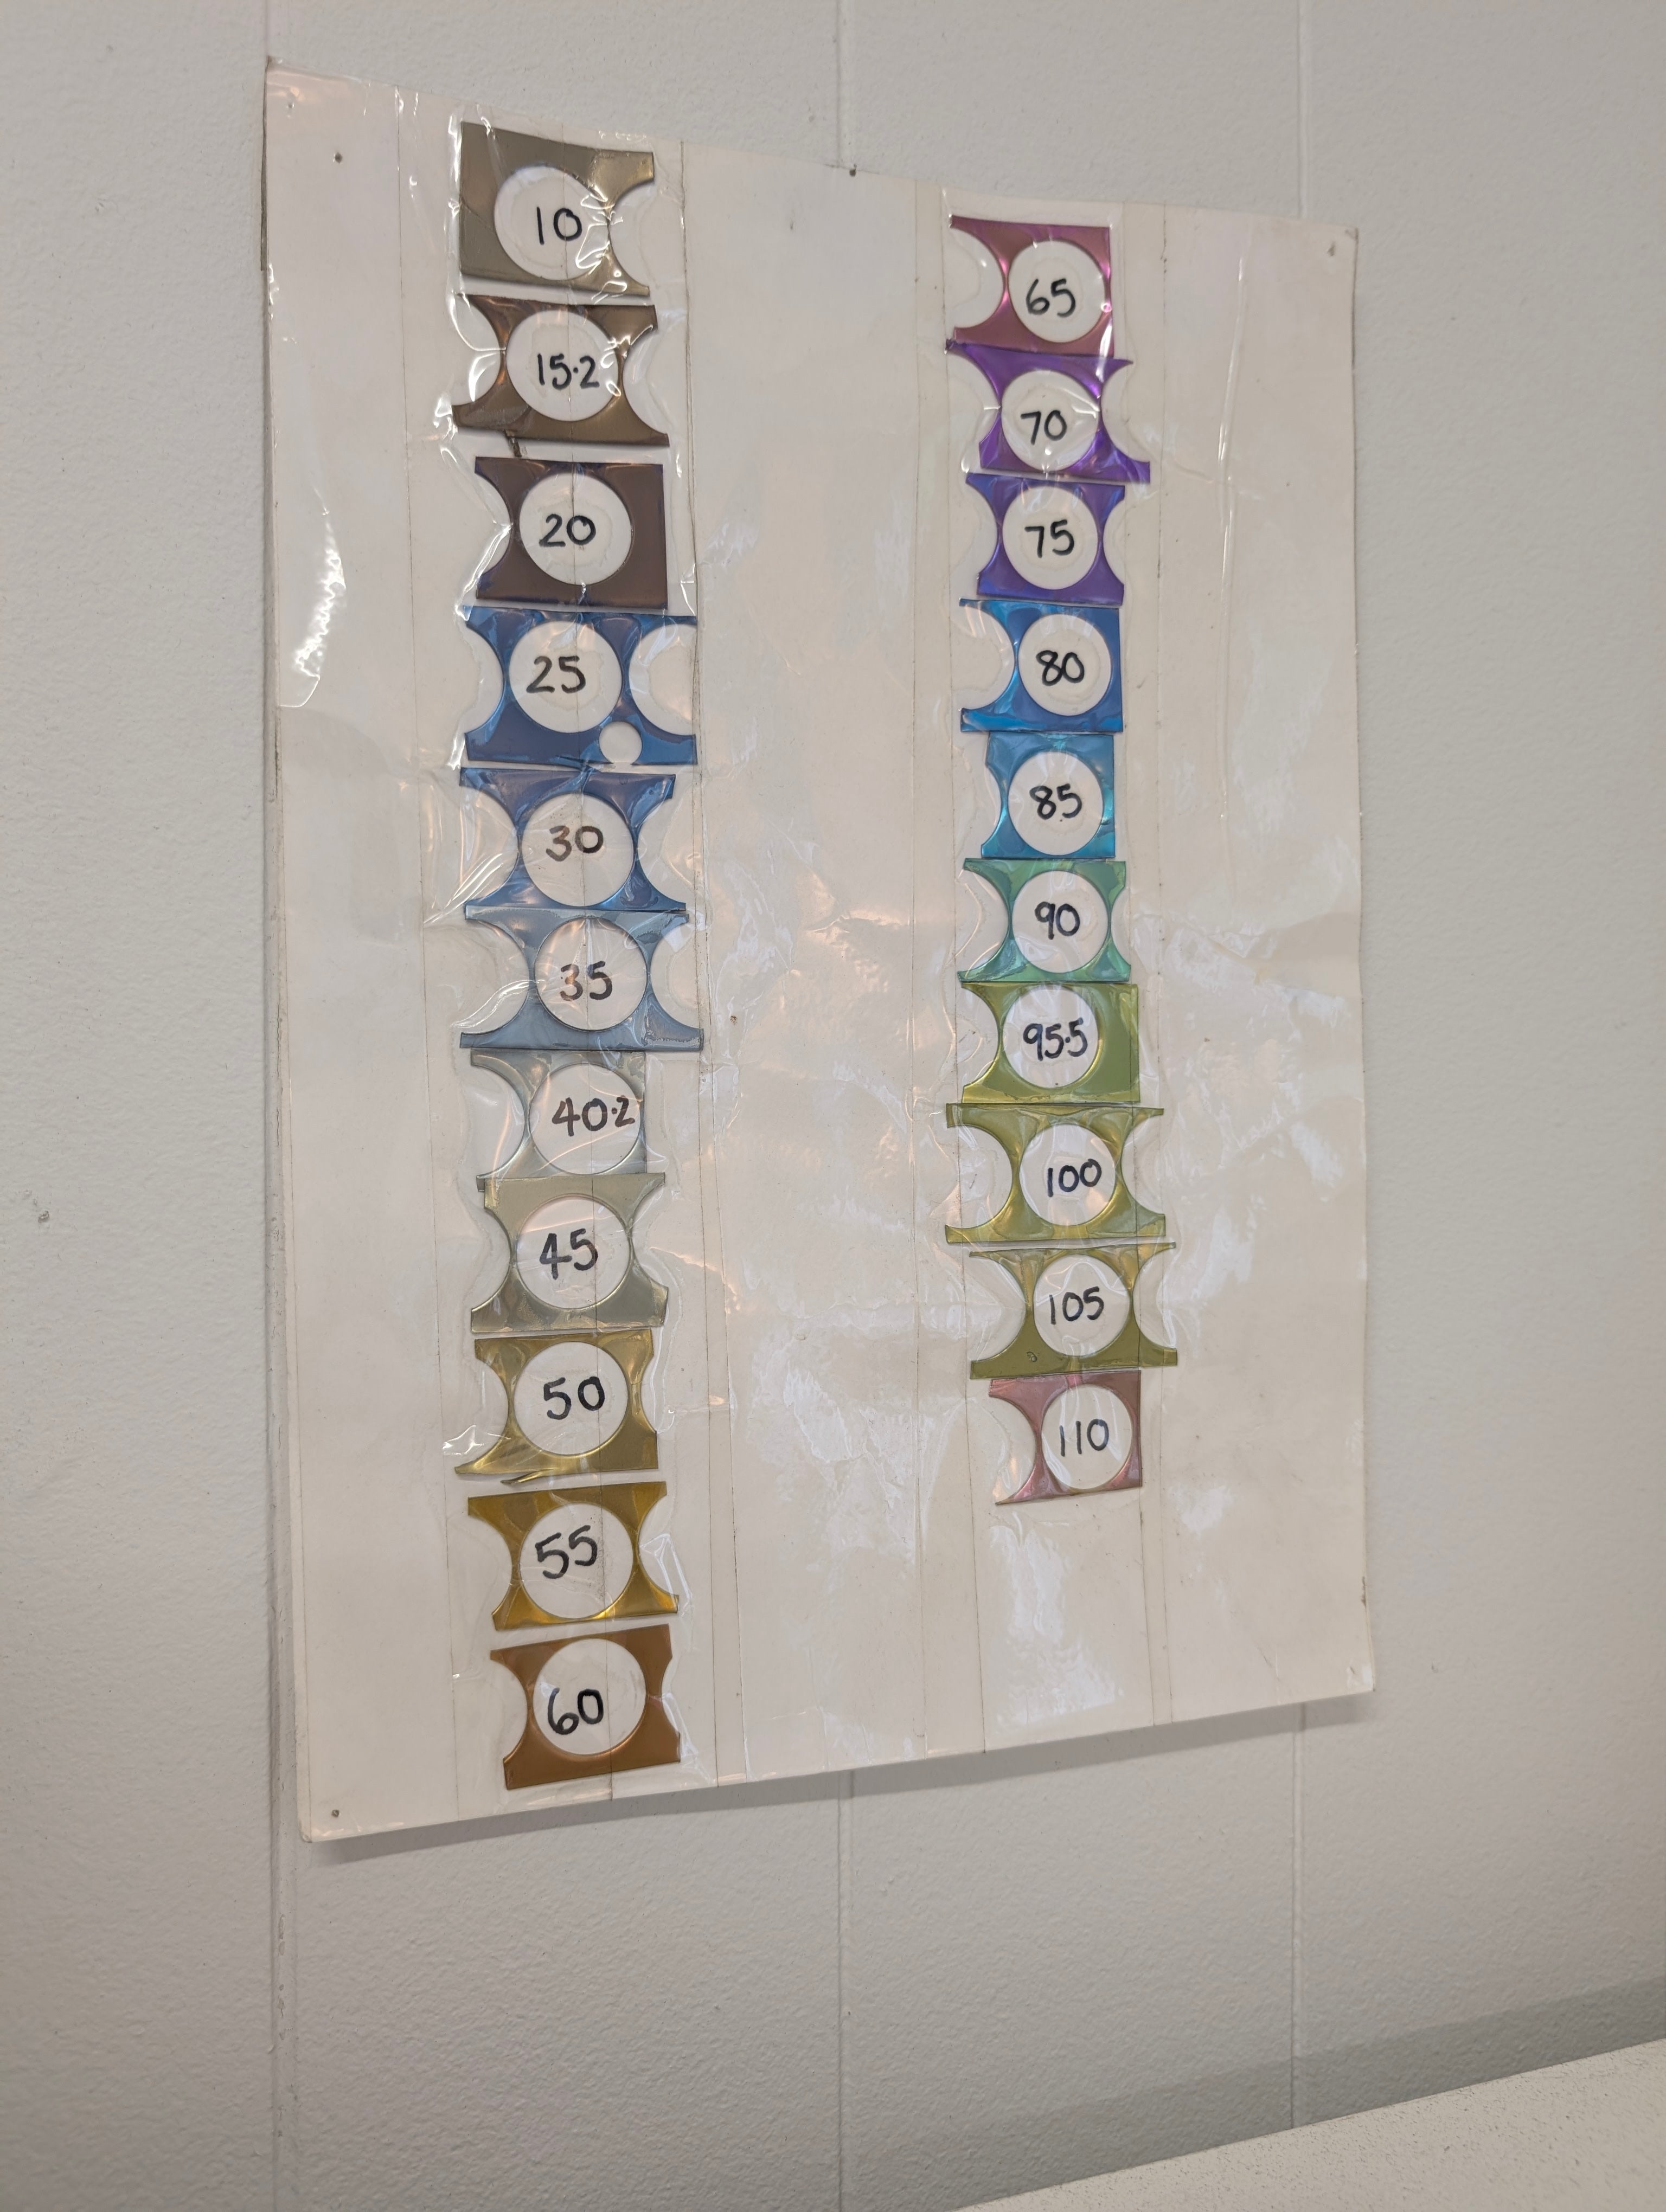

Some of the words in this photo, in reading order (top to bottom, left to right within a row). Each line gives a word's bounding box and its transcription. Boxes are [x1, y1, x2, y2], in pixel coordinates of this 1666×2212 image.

[536, 207, 582, 245] 10
[1026, 278, 1077, 317] 65
[1021, 409, 1067, 445] 70
[538, 513, 595, 547] 20
[1024, 519, 1074, 557] 75
[526, 655, 586, 693] 25
[1036, 650, 1085, 686] 80
[1030, 783, 1083, 820] 85
[546, 825, 604, 861] 30
[1035, 902, 1081, 940] 90
[559, 961, 613, 1001] 35
[1047, 1159, 1102, 1197] 100
[539, 1229, 598, 1281] 45
[1049, 1287, 1104, 1325] 105
[543, 1376, 606, 1420] 50
[1060, 1419, 1109, 1457] 110
[535, 1525, 598, 1579] 55
[547, 1688, 605, 1735] 60
